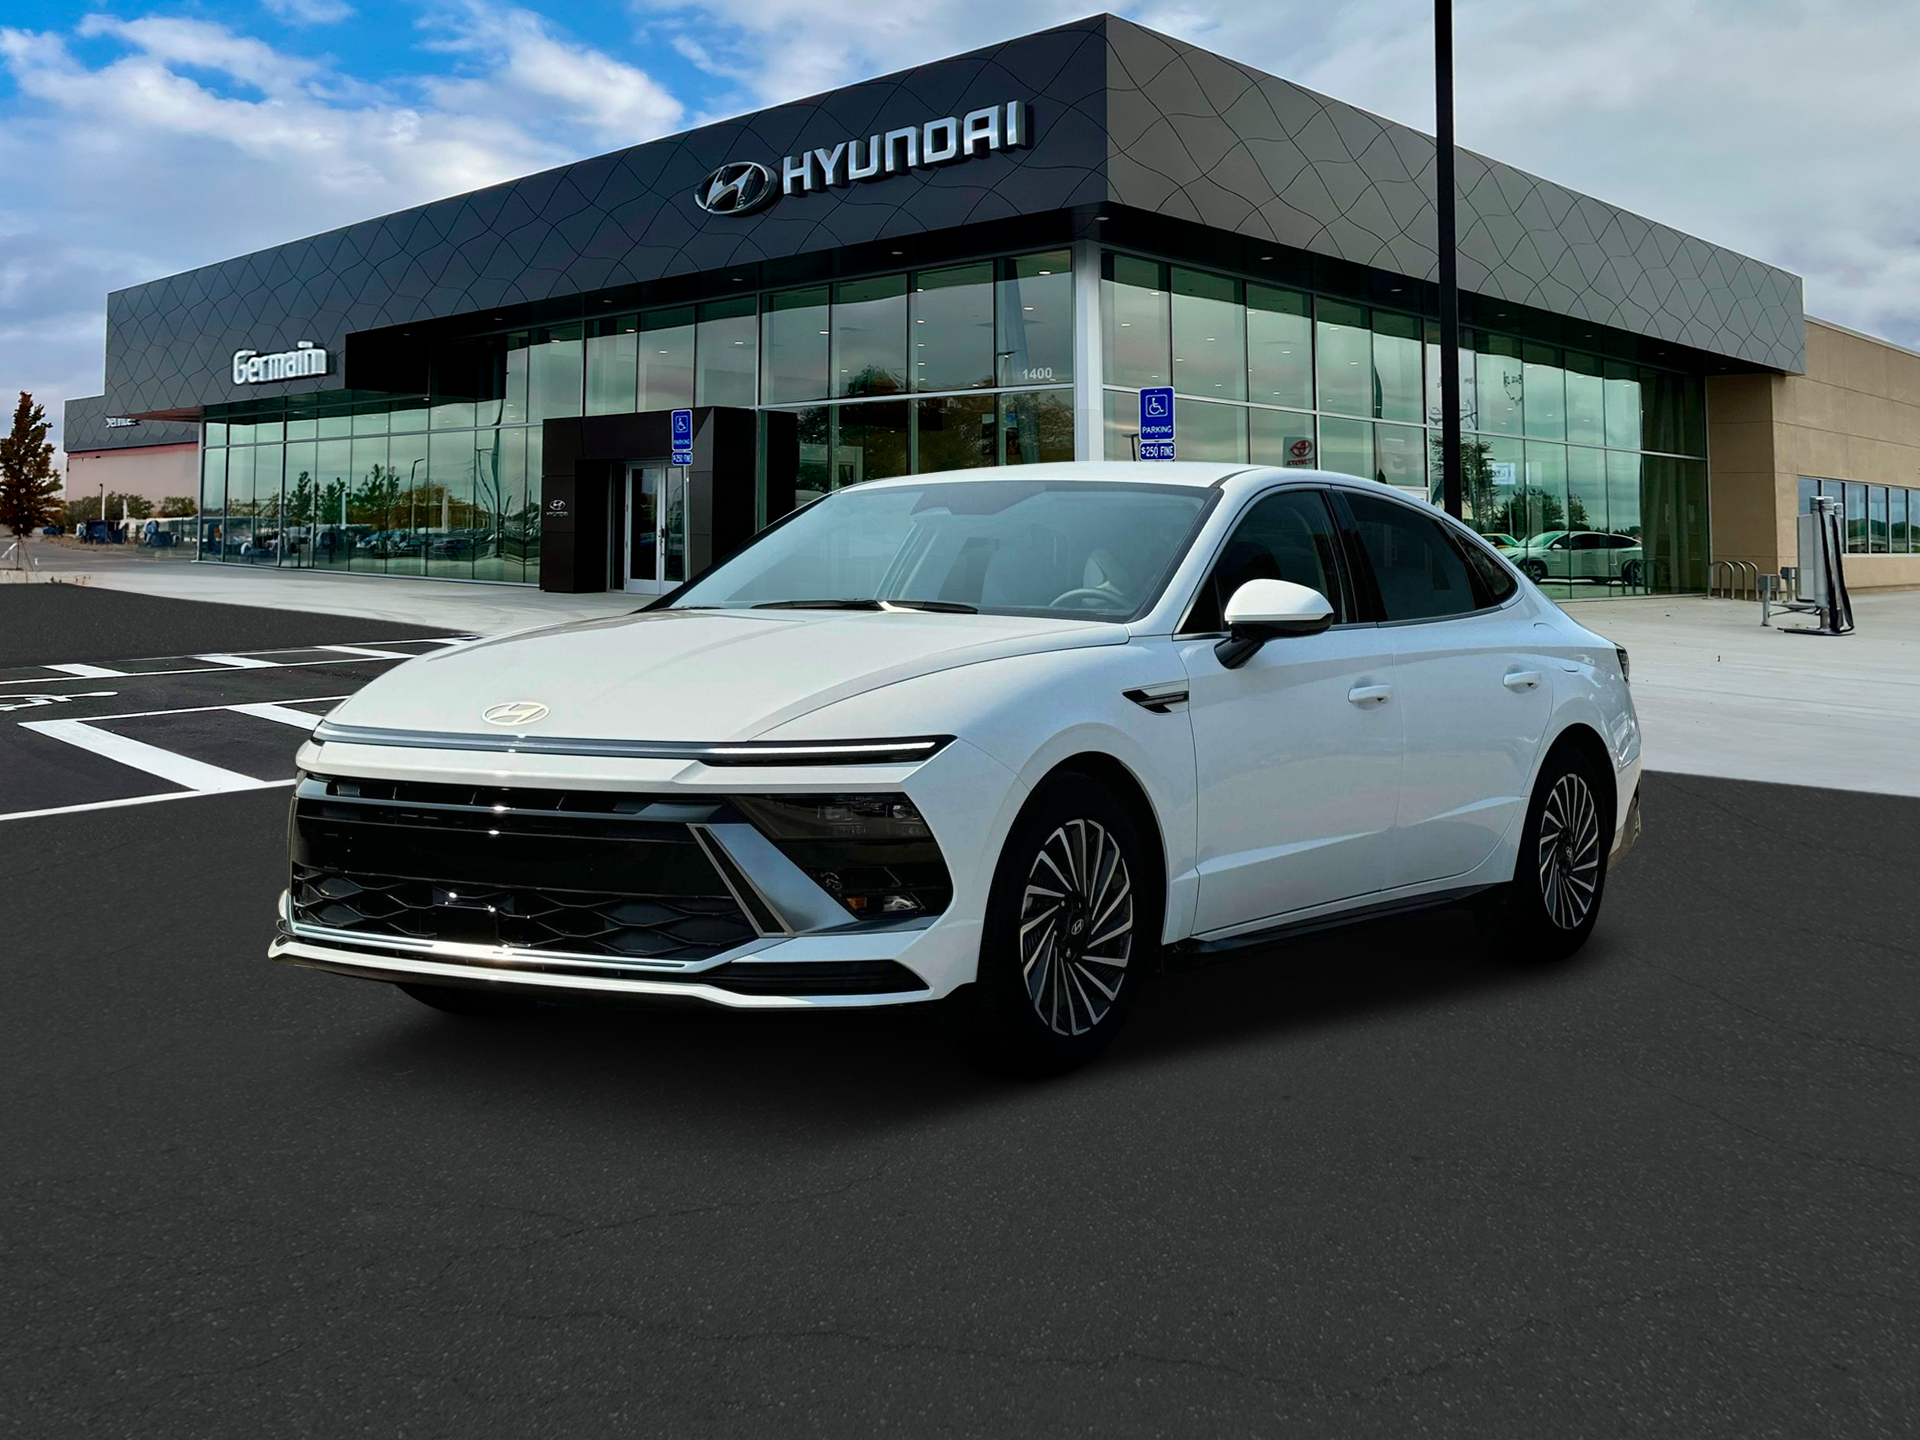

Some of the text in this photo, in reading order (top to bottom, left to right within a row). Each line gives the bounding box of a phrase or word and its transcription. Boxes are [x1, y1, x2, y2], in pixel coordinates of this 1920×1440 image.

[782, 100, 1029, 196] HYUNDAI
[233, 340, 328, 385] Germain
[1022, 366, 1053, 380] 1400
[1141, 425, 1173, 434] PARKING
[1160, 445, 1174, 457] FINE
